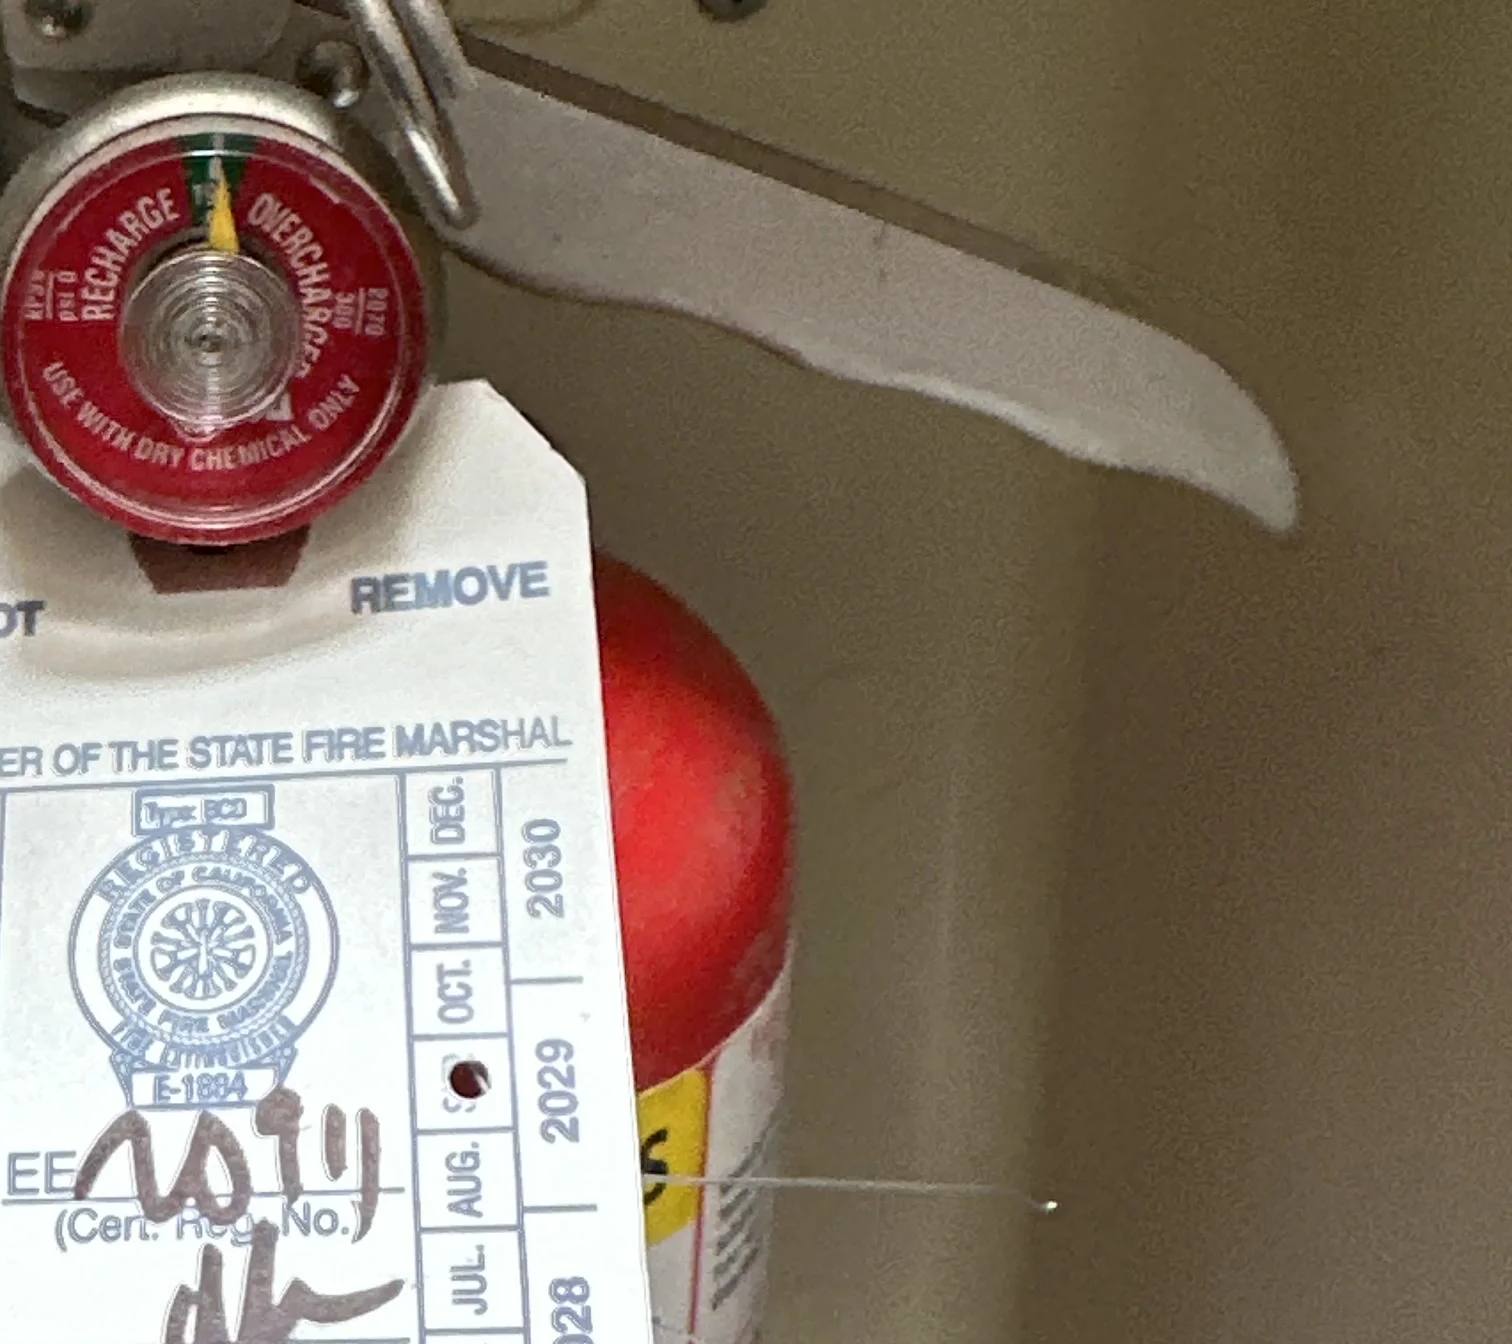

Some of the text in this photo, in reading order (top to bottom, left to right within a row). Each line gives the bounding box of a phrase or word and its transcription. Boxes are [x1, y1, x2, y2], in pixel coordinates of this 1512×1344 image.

[81, 187, 180, 321] RECHARGE
[42, 361, 360, 472] USE WITH DRY CHEMICAL ONLY
[351, 561, 550, 616] REMOVE
[51, 743, 101, 775] OF
[108, 738, 180, 773] THE
[189, 732, 294, 769] STATE
[302, 726, 387, 763] FIRE
[396, 715, 573, 758] MARSHAL
[428, 776, 465, 845] DEC.
[432, 867, 470, 935] NOV.
[521, 818, 564, 919] 2030
[436, 958, 474, 1025] OCT.
[535, 1038, 580, 1144] 2029
[445, 1141, 483, 1219] AUG.
[54, 1207, 159, 1253] (Cert.
[177, 1206, 268, 1247] Reg
[449, 1244, 488, 1316] JUL.
